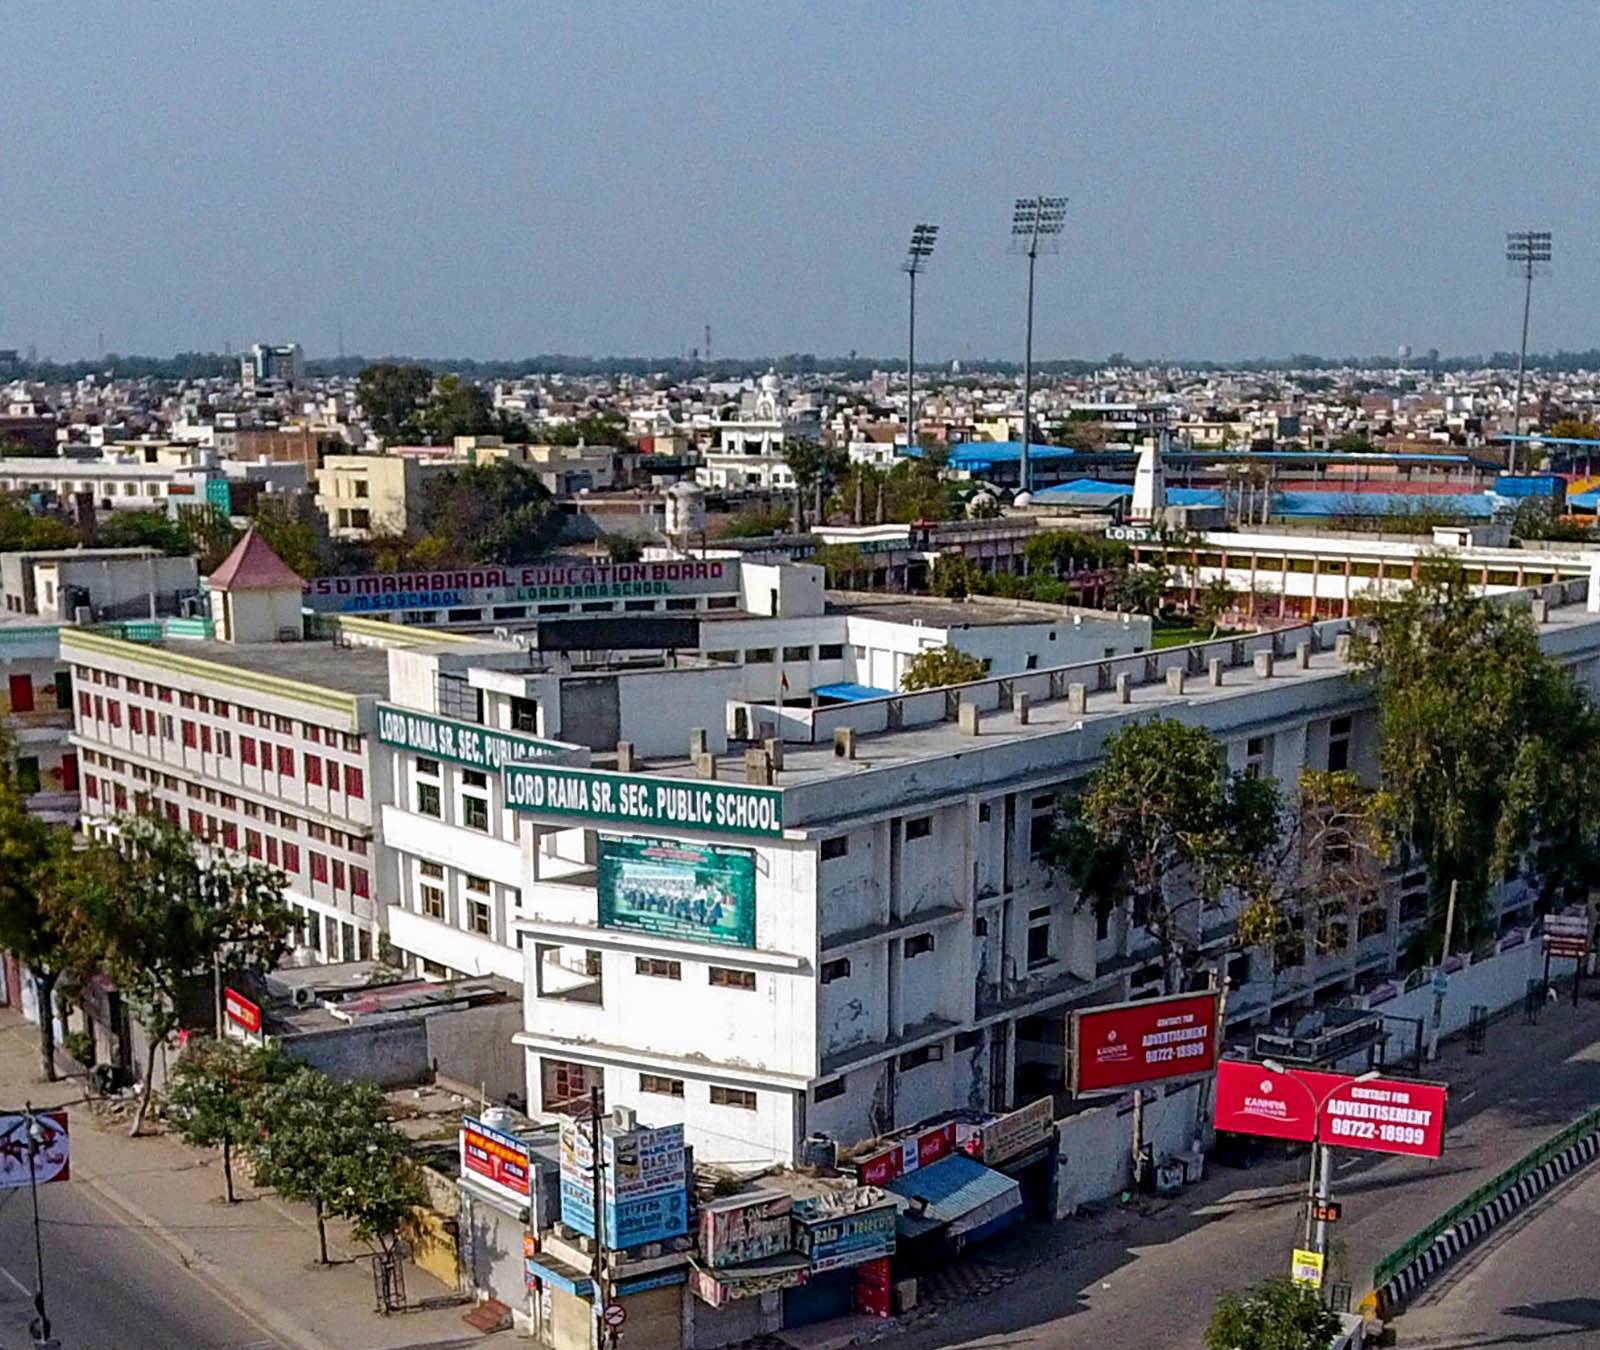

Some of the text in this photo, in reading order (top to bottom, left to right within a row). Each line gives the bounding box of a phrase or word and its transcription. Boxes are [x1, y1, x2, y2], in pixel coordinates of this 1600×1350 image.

[1105, 528, 1147, 541] LORD
[357, 570, 516, 594] MAHABIRDAL
[522, 563, 646, 586] EDUCATION
[652, 562, 723, 580] BOARD
[517, 581, 673, 600] LORD RAMA SCHOOL
[378, 710, 406, 745] LORD
[408, 715, 437, 753] RAMA
[439, 723, 457, 757] SR.
[459, 728, 484, 766] SEC.
[506, 772, 781, 831] LORD RAMA SR. SEC. PUBLIC SCHOOL
[1351, 1087, 1409, 1103] CONTACT FOR
[1327, 1099, 1432, 1126] ADVERTISEMENT
[1331, 1118, 1425, 1145] 98722-18999
